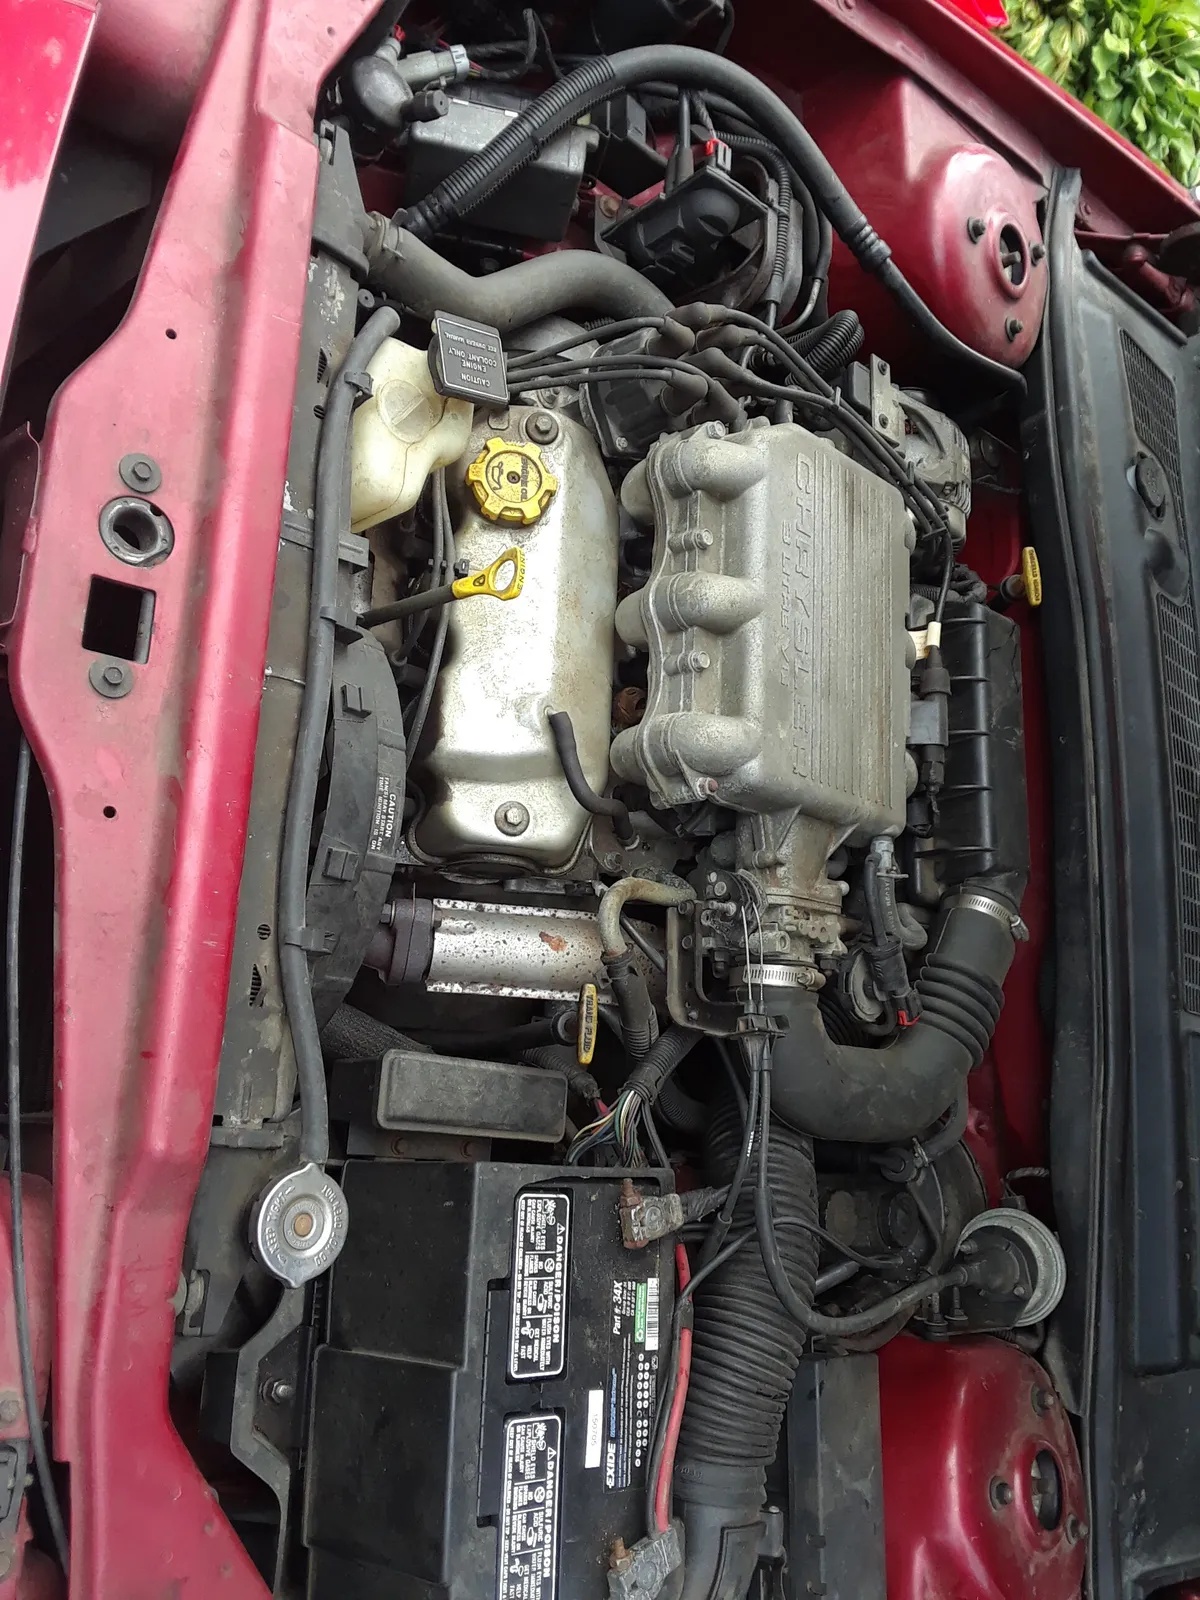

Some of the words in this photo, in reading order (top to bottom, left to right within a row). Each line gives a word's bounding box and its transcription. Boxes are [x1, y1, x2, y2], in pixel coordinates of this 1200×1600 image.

[444, 332, 465, 343] MANUAL
[448, 347, 466, 358] ONLY
[468, 354, 497, 367] COOLANT
[461, 360, 487, 374] ENGINE
[461, 373, 491, 387] CAUTION
[517, 552, 526, 592] ENGINE
[780, 552, 790, 630] LITRE
[793, 452, 811, 779] CHRYSLER
[375, 796, 383, 825] IGNITION
[385, 793, 397, 838] CAUTION
[373, 828, 379, 836] IS
[371, 840, 377, 850] ON
[586, 994, 594, 1024] TRANS
[584, 1027, 593, 1053] FLUID
[539, 1261, 544, 1270] NO
[553, 1236, 563, 1343] DANGER/POISON
[612, 1280, 623, 1305] 34X
[612, 1315, 621, 1335] Part
[590, 1413, 599, 1446] 150705
[606, 1443, 616, 1489] EXIDE
[528, 1491, 533, 1500] NO
[543, 1461, 554, 1577] DANGER/POISON
